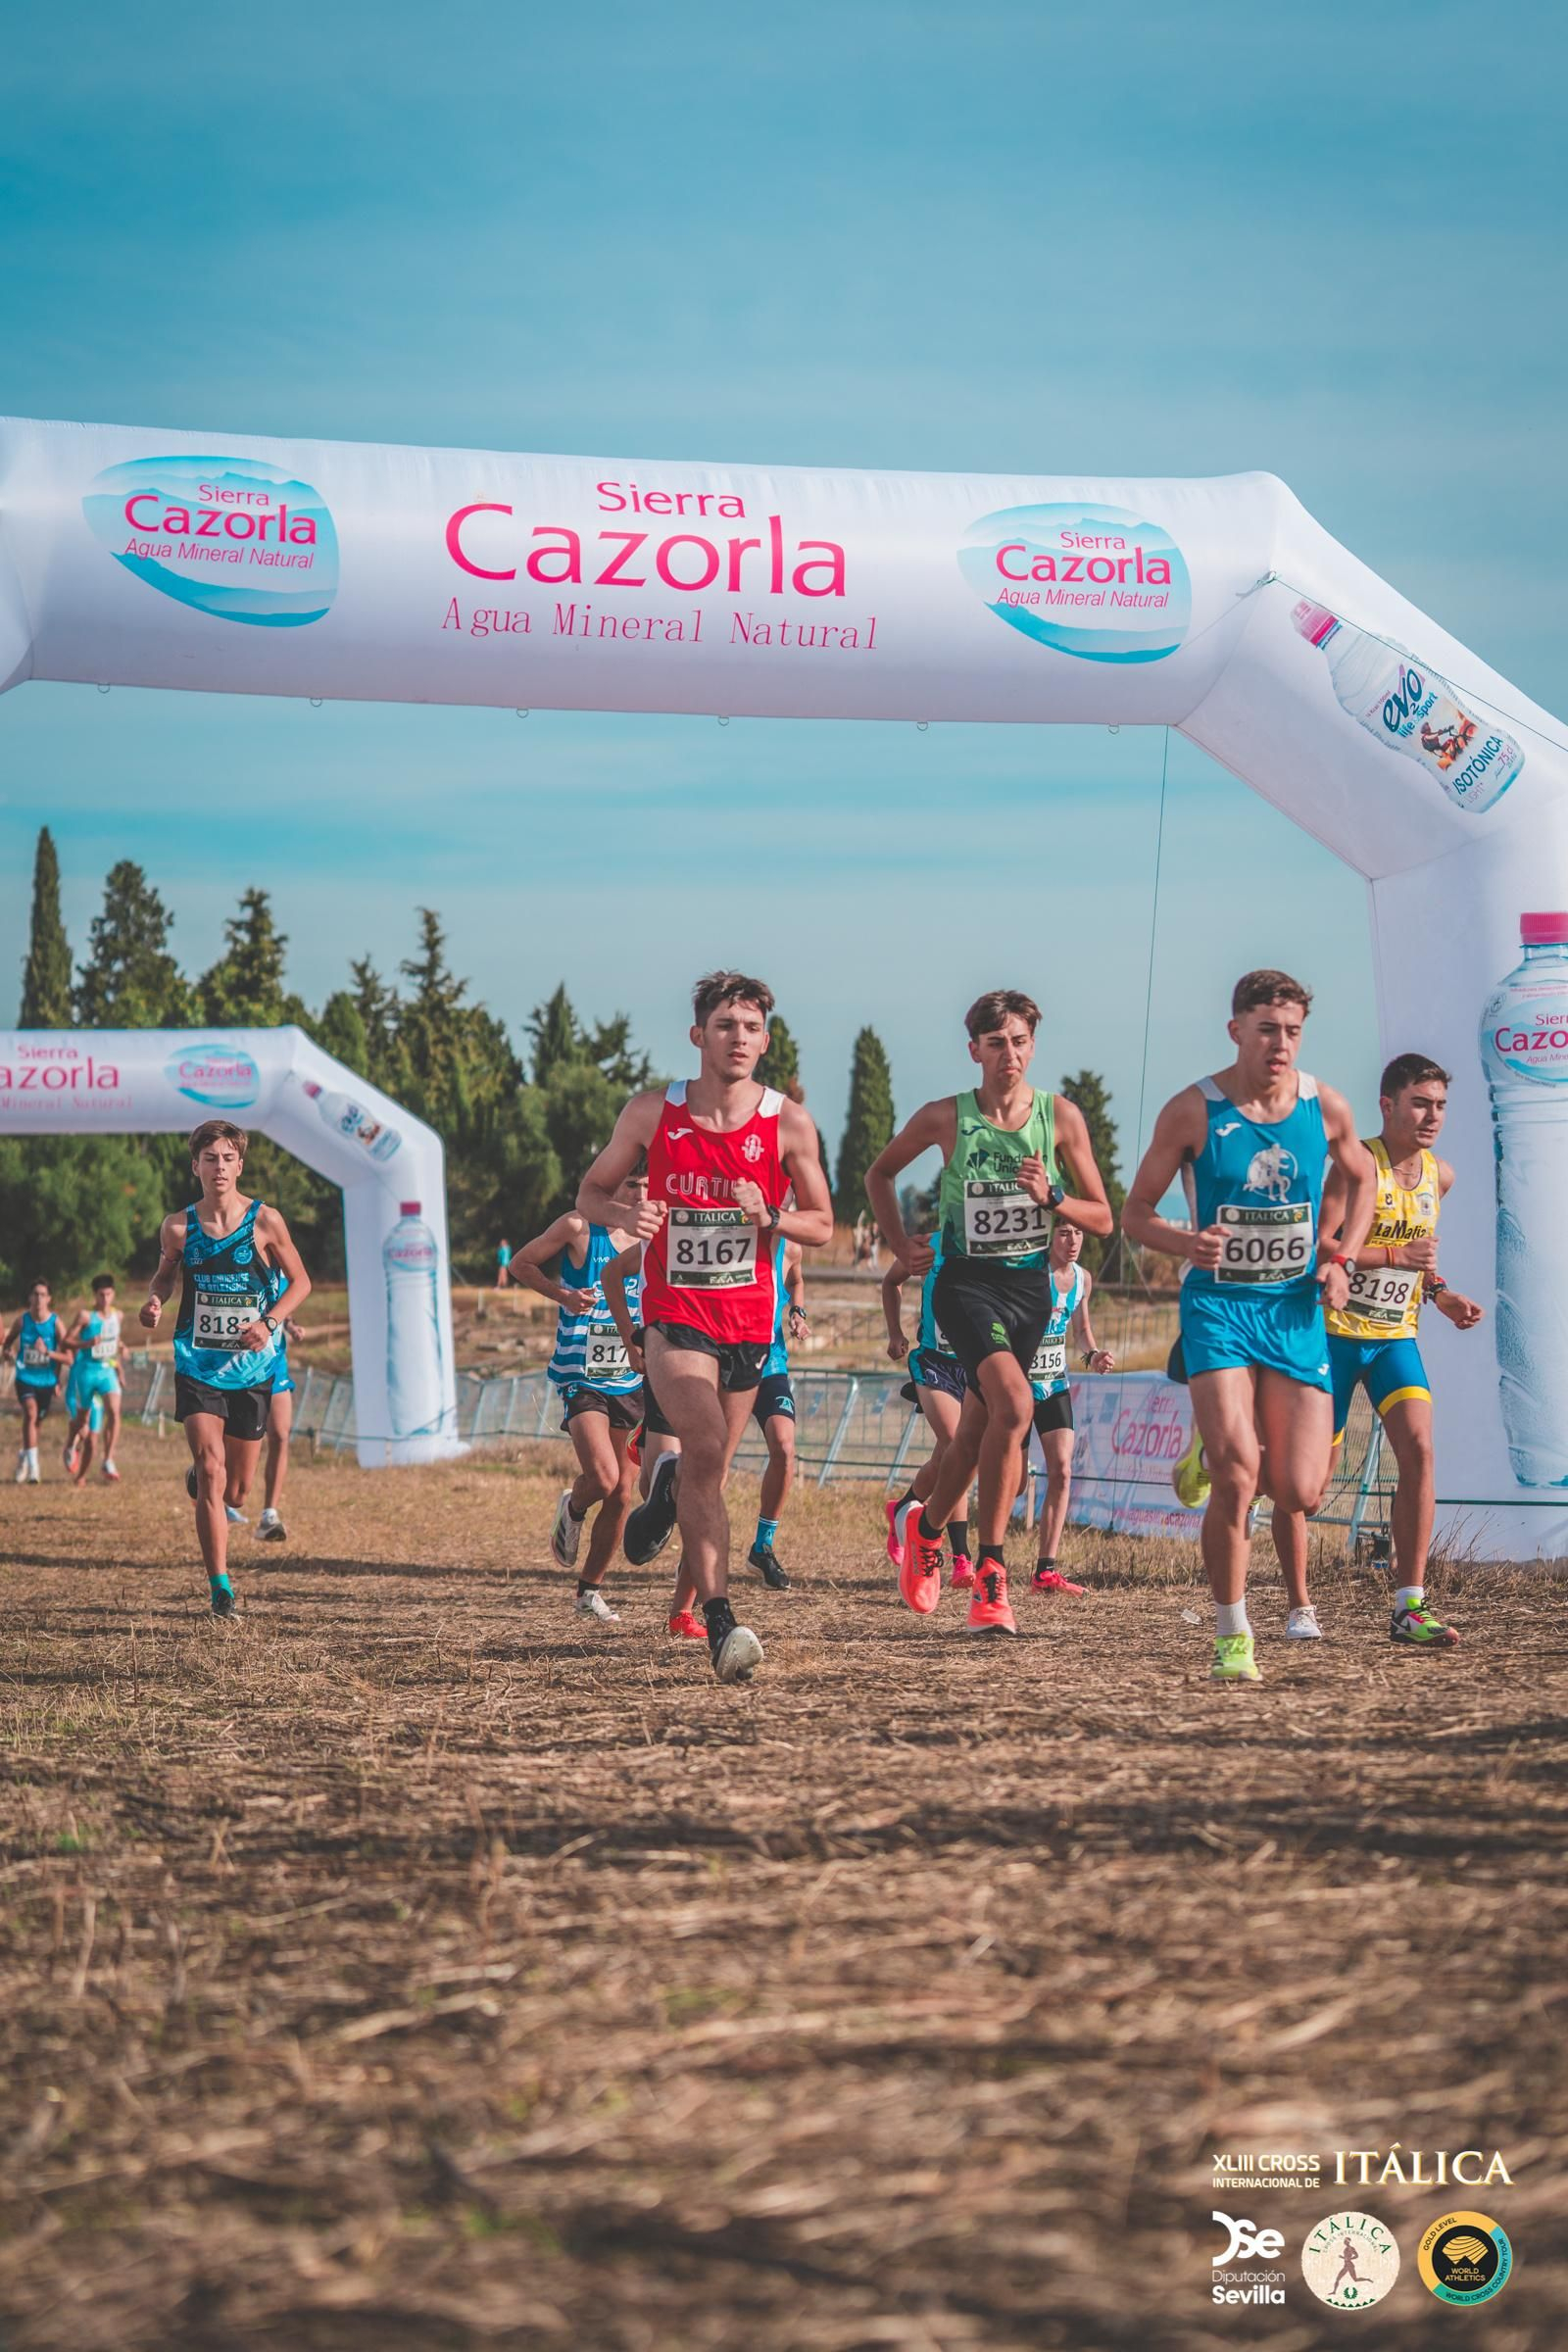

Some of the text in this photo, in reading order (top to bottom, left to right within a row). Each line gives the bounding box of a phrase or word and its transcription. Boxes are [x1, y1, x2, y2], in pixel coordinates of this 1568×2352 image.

[199, 484, 270, 507] Sierra
[596, 481, 746, 518] Sierra
[124, 494, 317, 545] Cazorla
[124, 538, 314, 568] Agua Mineral Natural
[445, 502, 846, 597] Cazorla
[1059, 531, 1126, 550] Sierra
[996, 544, 1171, 585] Cazorla
[997, 588, 1169, 609] Agua Mineral Natural
[441, 597, 878, 650] Agua Mineral Natural
[1383, 668, 1423, 732] evo
[1396, 691, 1439, 738] life sport
[1452, 735, 1504, 795] ISOTÓNICA
[18, 1046, 79, 1059] Sierra
[974, 1207, 1046, 1235] 8231
[676, 1238, 751, 1265] 8167
[1225, 1237, 1304, 1263] 6066
[1348, 1273, 1409, 1303] 8198
[1112, 1408, 1182, 1458] Cazorla
